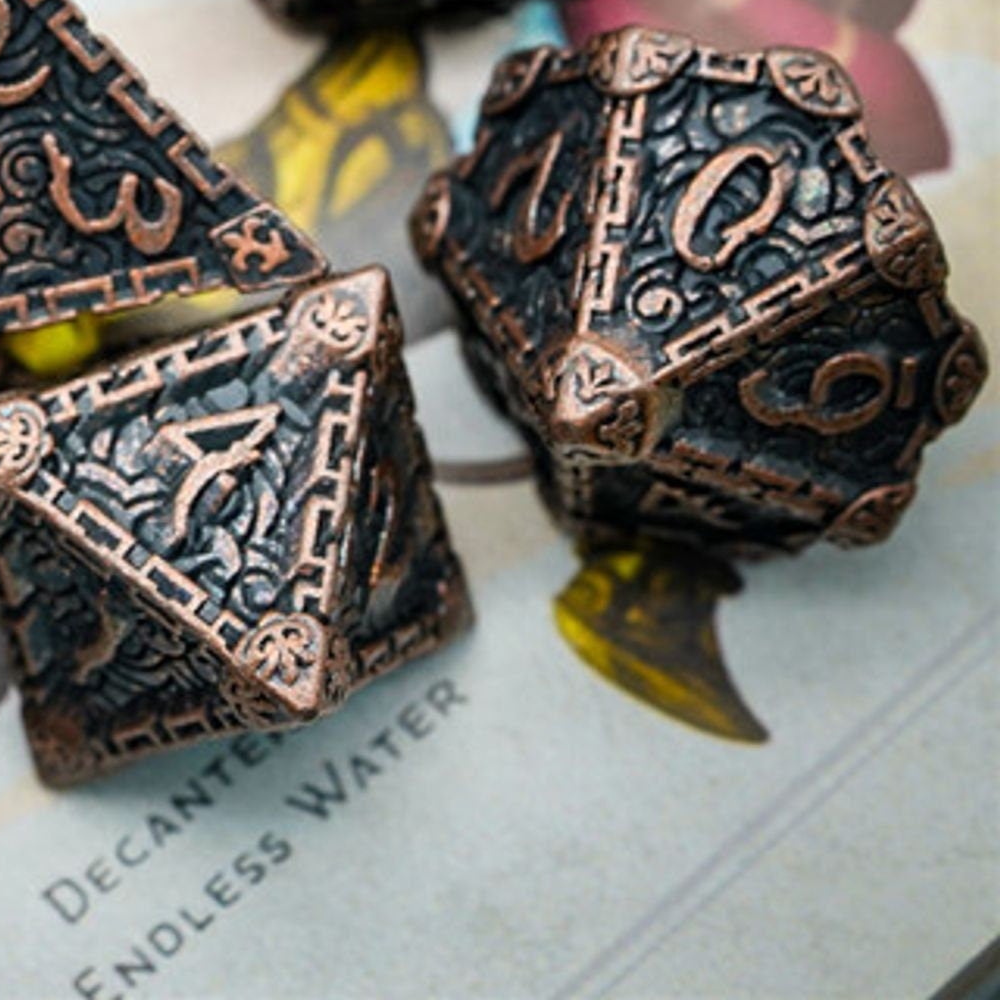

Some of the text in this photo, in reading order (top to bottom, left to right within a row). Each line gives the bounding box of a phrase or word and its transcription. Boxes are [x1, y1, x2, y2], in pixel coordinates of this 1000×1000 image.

[43, 133, 183, 255] 3
[43, 731, 287, 924] DECANTE
[73, 677, 471, 1000] ENDLESS WATER
